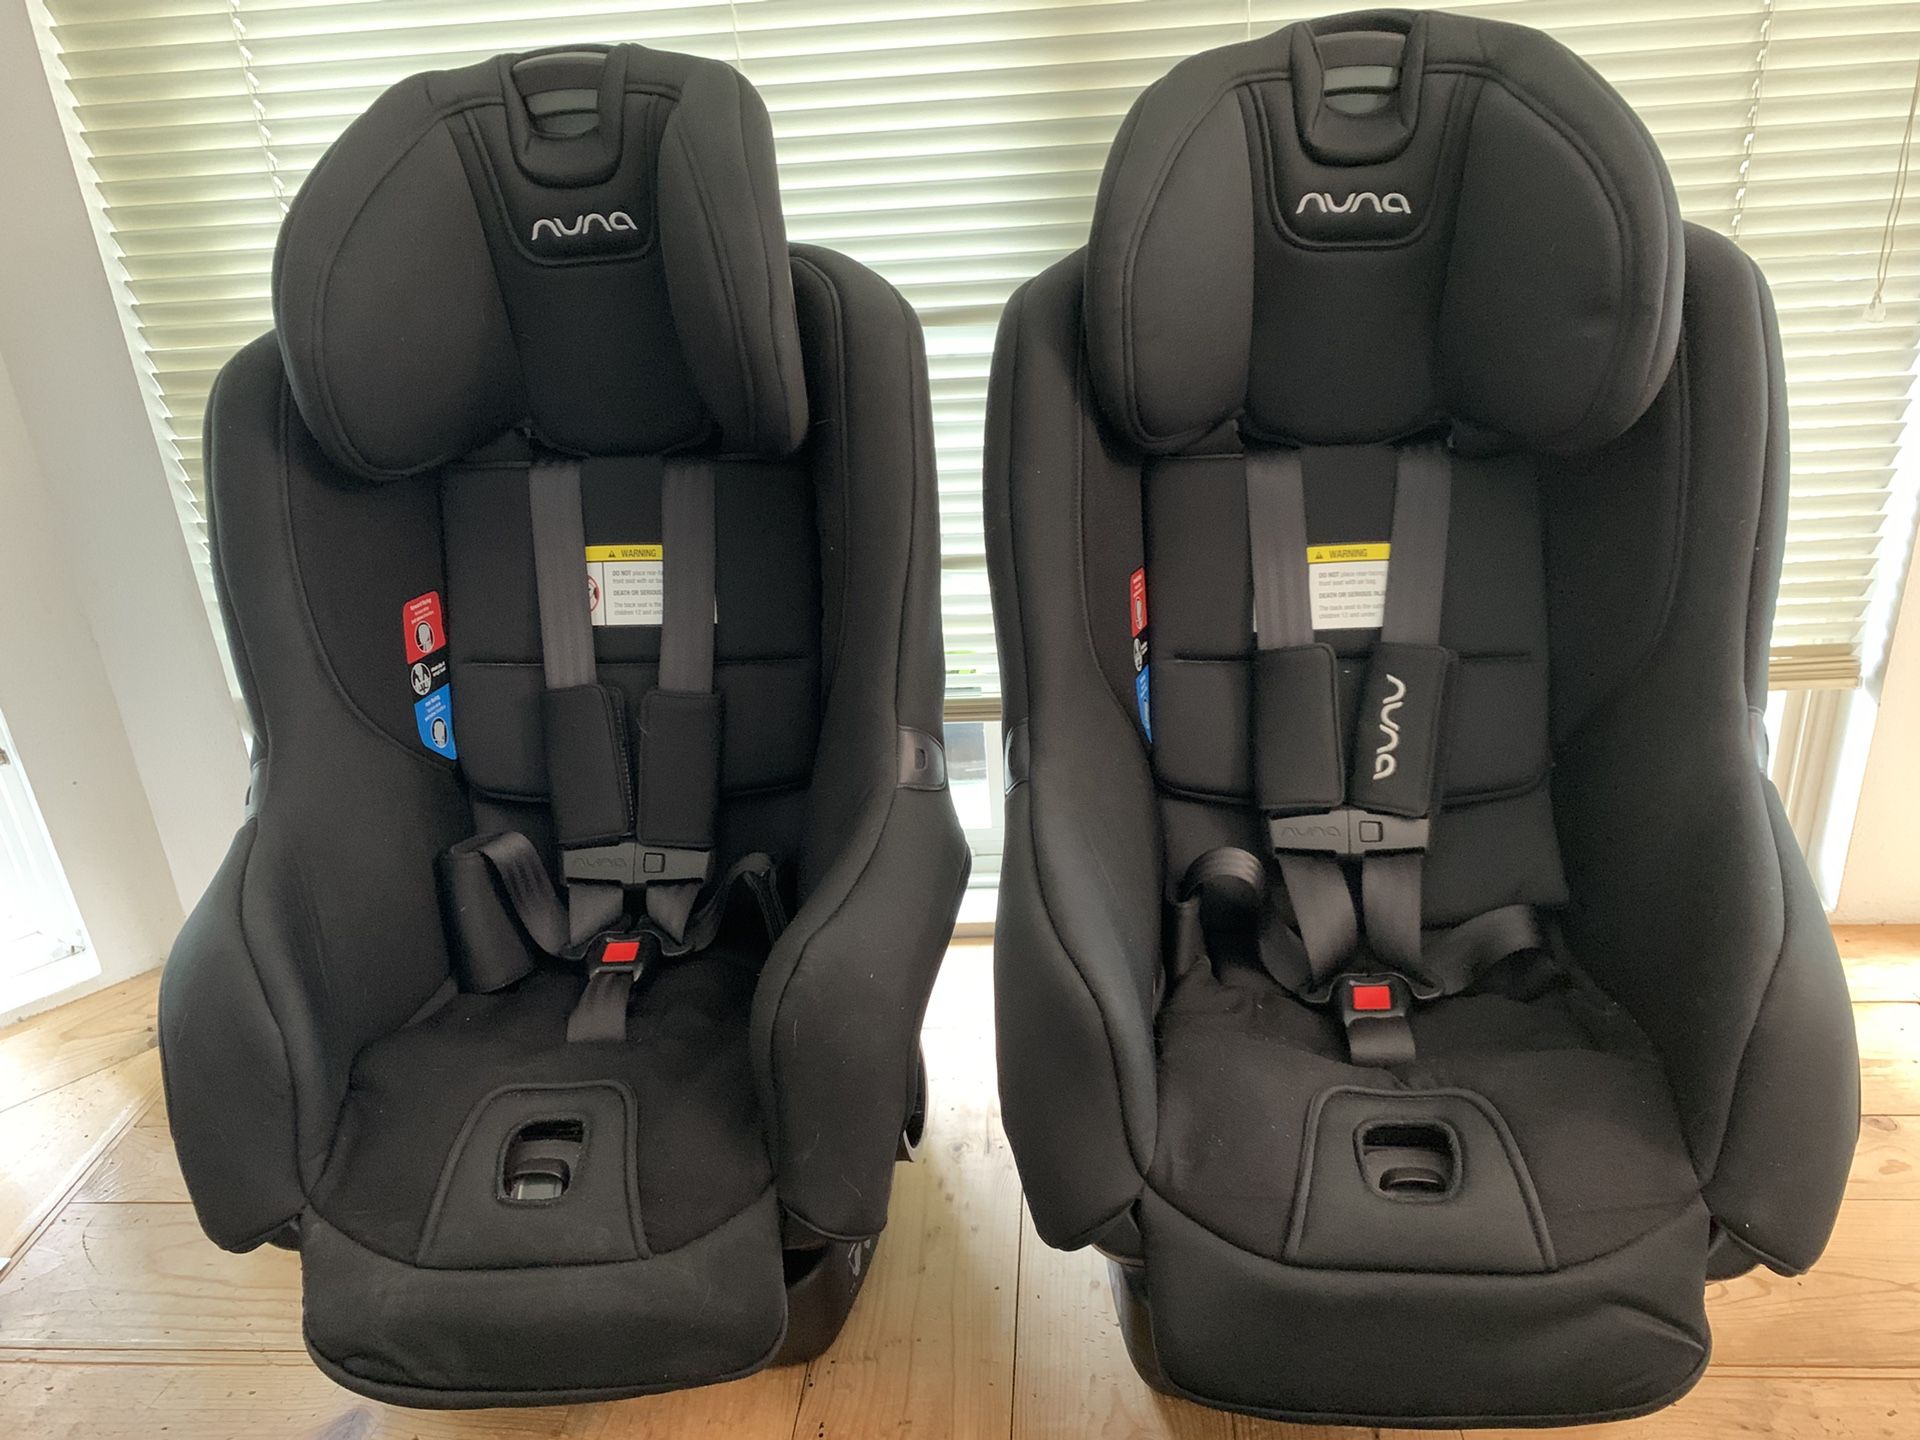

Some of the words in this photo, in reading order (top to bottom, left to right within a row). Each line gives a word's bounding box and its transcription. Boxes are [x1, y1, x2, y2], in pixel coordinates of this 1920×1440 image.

[1296, 192, 1411, 214] nuna
[531, 212, 638, 241] nuna
[620, 549, 657, 558] WARNING
[1328, 548, 1368, 559] WARNING
[1372, 673, 1406, 780] nuna
